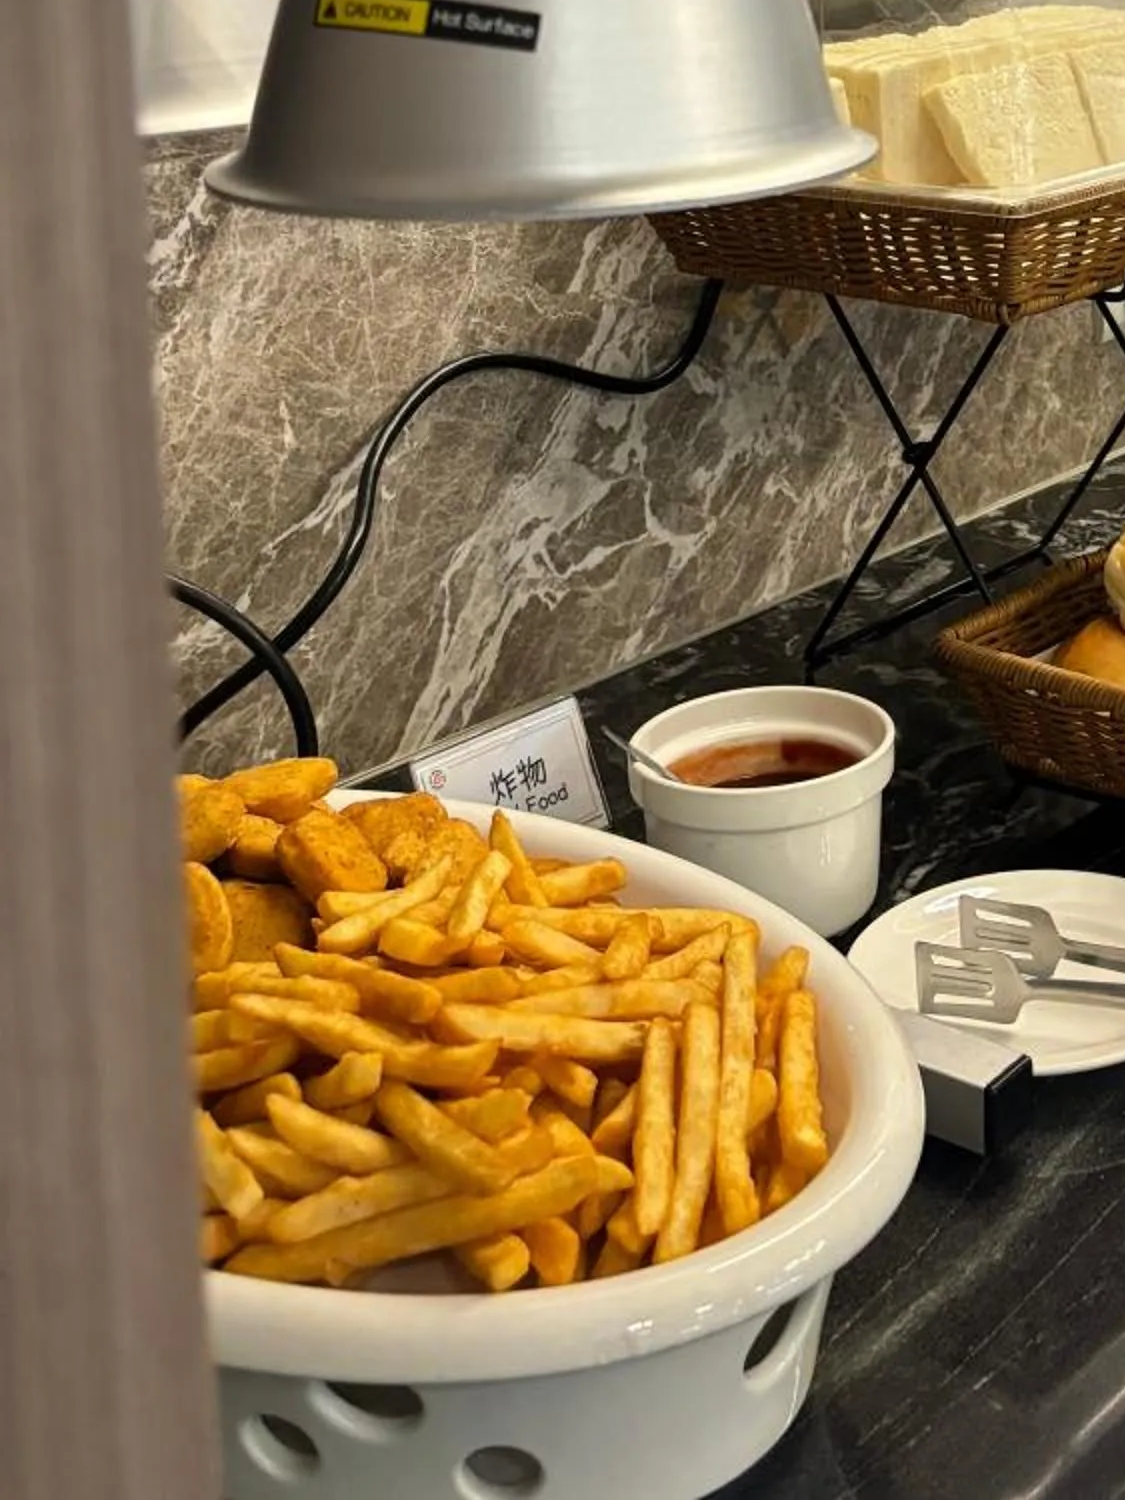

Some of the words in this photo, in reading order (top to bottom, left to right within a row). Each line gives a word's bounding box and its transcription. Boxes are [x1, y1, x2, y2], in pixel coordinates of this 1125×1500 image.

[345, 1, 411, 21] CAUTION
[432, 8, 464, 27] Hot
[464, 11, 535, 39] Surface
[489, 756, 547, 806] 炸物
